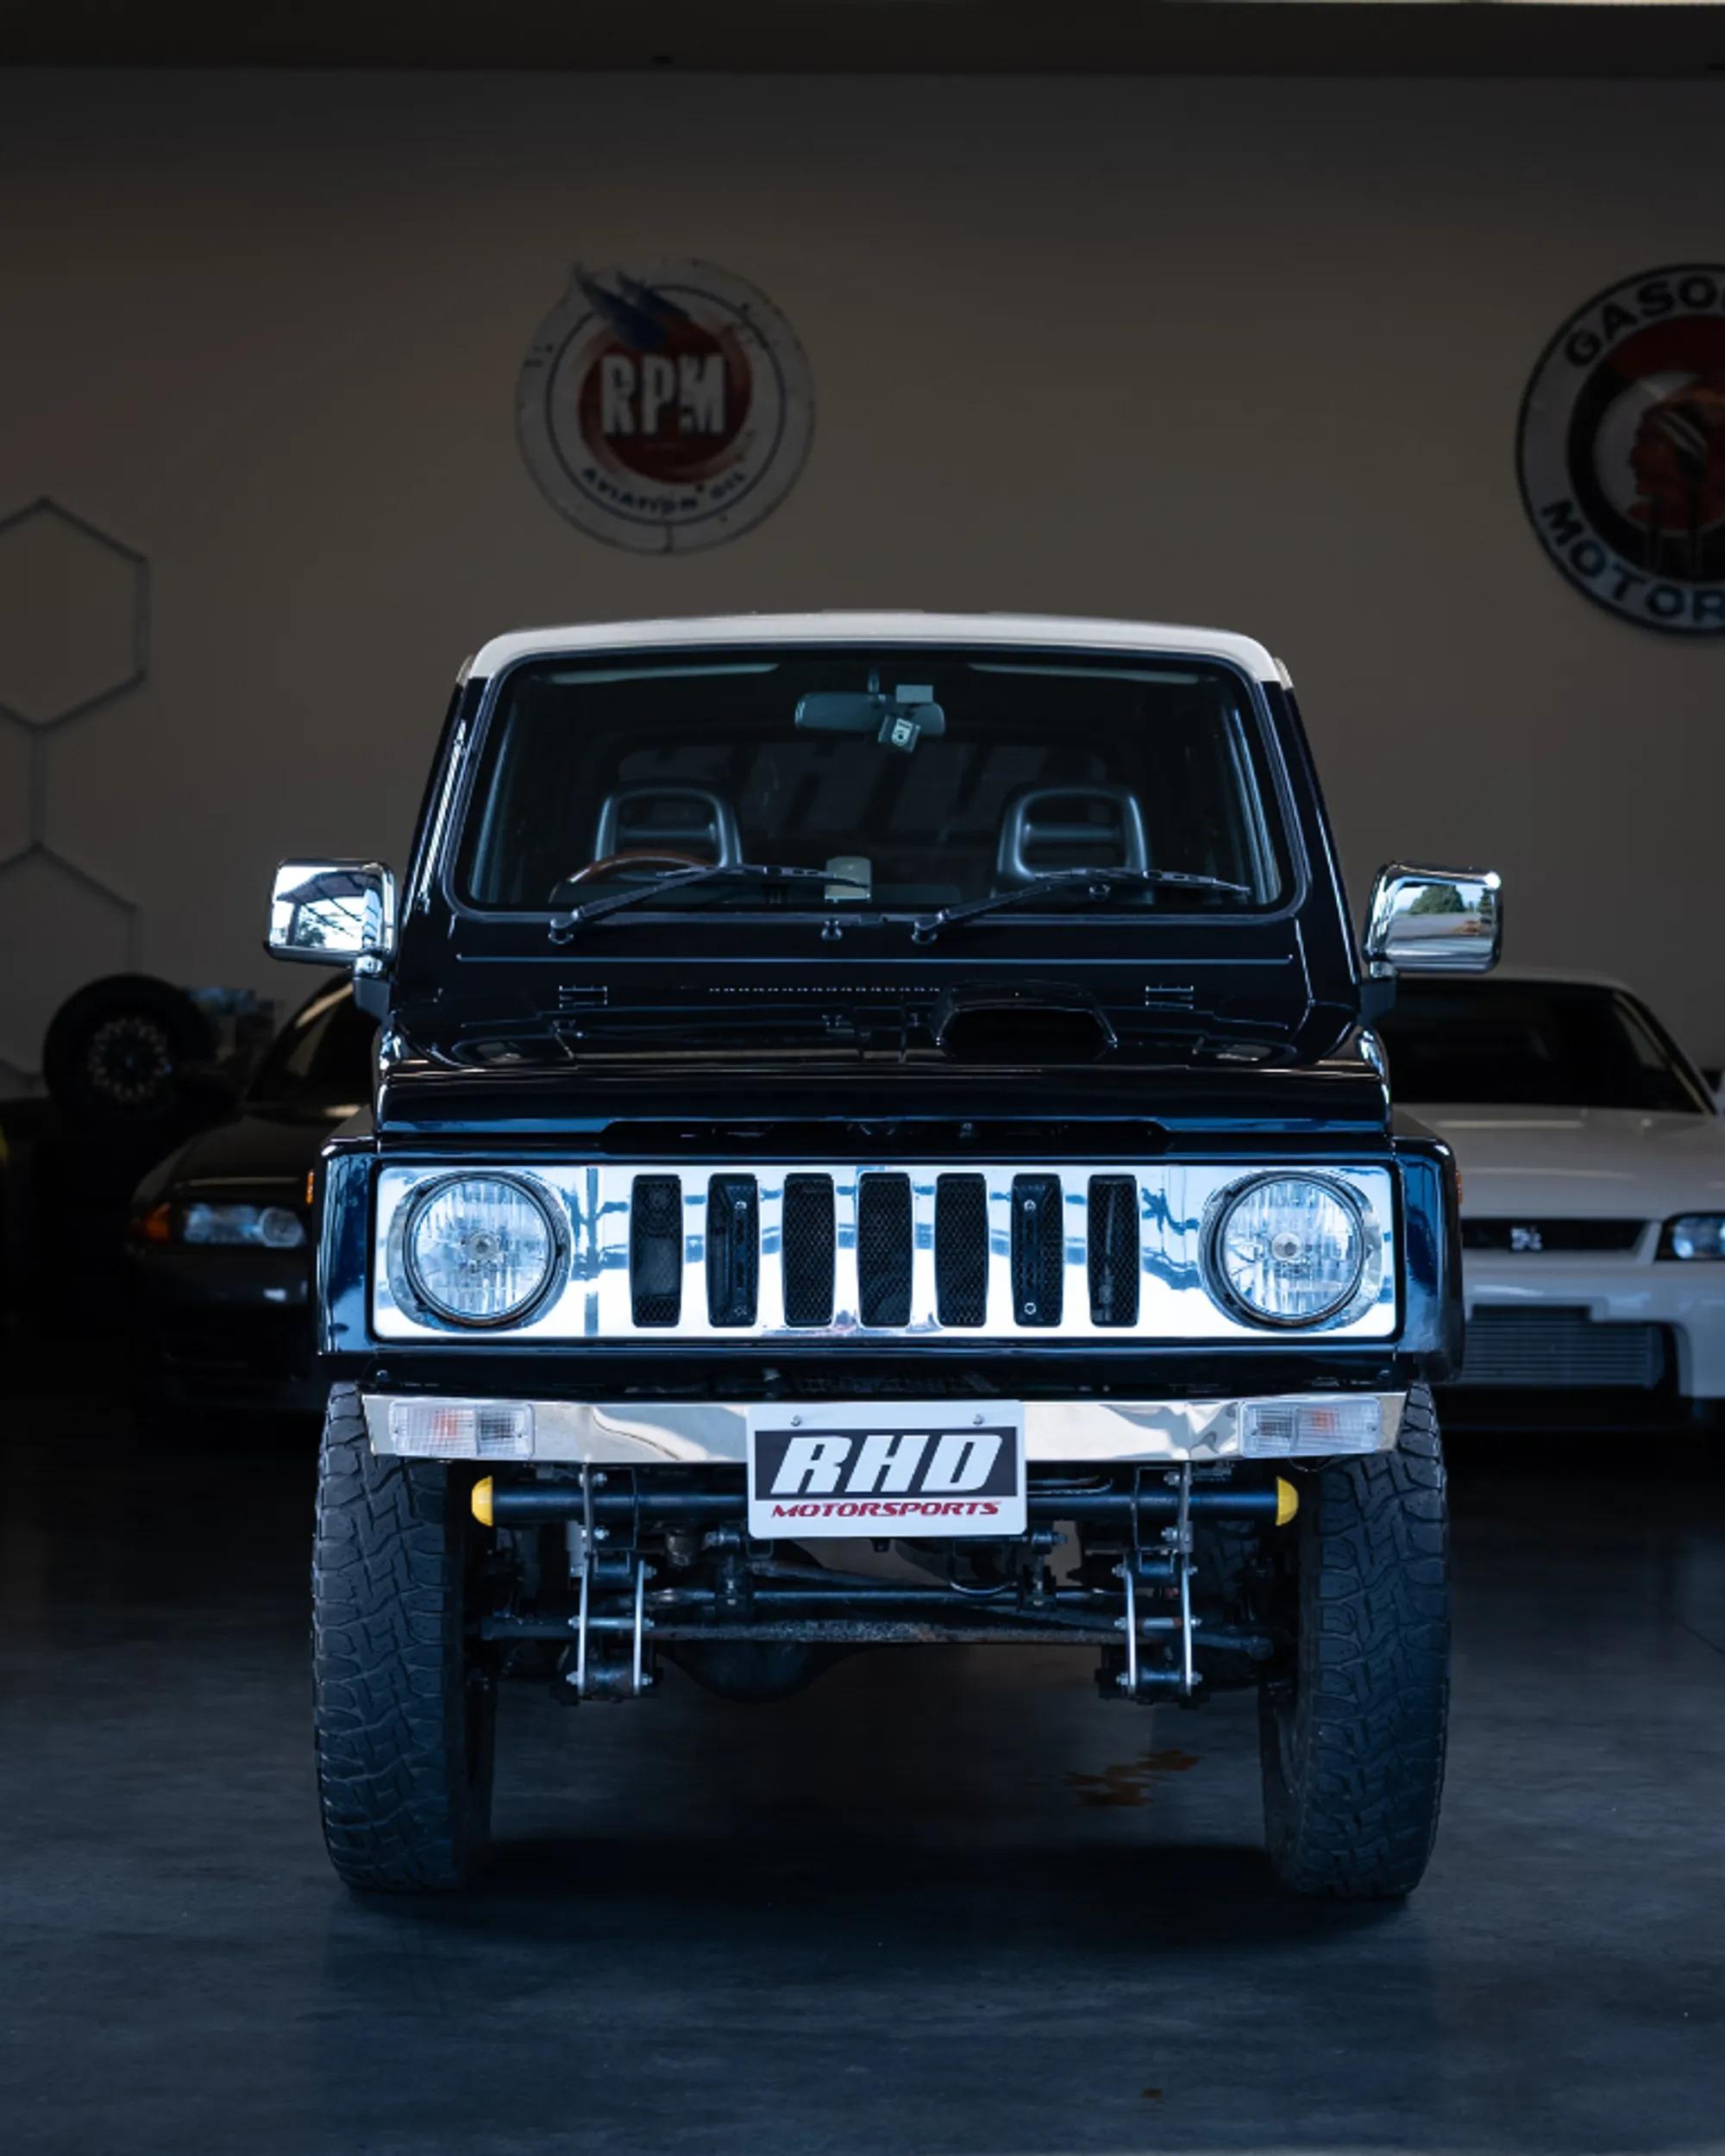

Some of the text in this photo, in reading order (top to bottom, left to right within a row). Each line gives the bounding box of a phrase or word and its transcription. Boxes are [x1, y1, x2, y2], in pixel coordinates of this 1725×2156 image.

[1565, 276, 1725, 367] GASO
[600, 352, 727, 435] RPM
[770, 1435, 1003, 1494] RHD
[772, 1502, 1002, 1518] MOTORSPORTS
